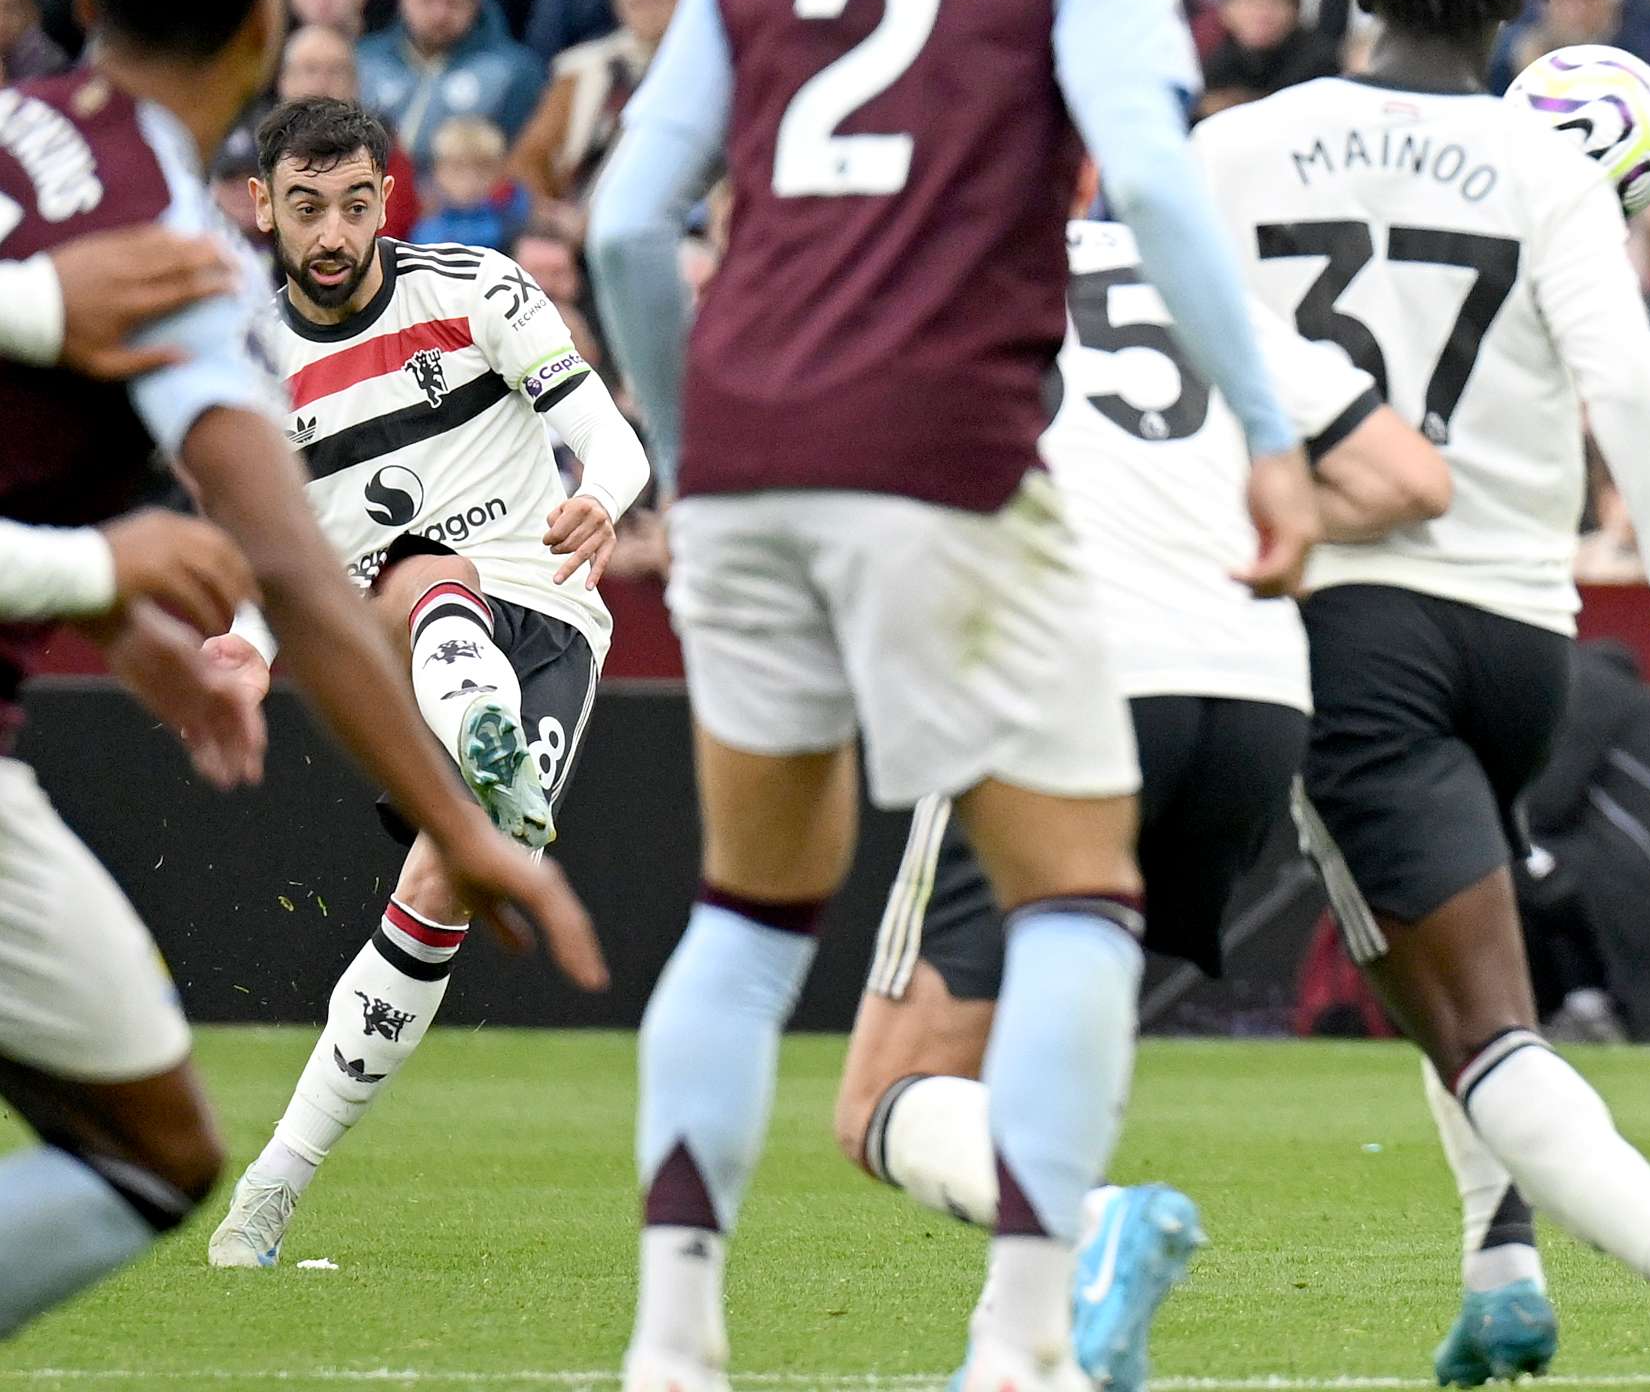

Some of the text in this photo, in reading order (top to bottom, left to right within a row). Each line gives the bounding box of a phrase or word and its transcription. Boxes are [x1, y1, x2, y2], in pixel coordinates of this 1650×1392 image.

[1291, 127, 1499, 203] MAINOO
[1067, 264, 1211, 442] 5
[1256, 220, 1521, 446] 37
[528, 715, 566, 790] 8
